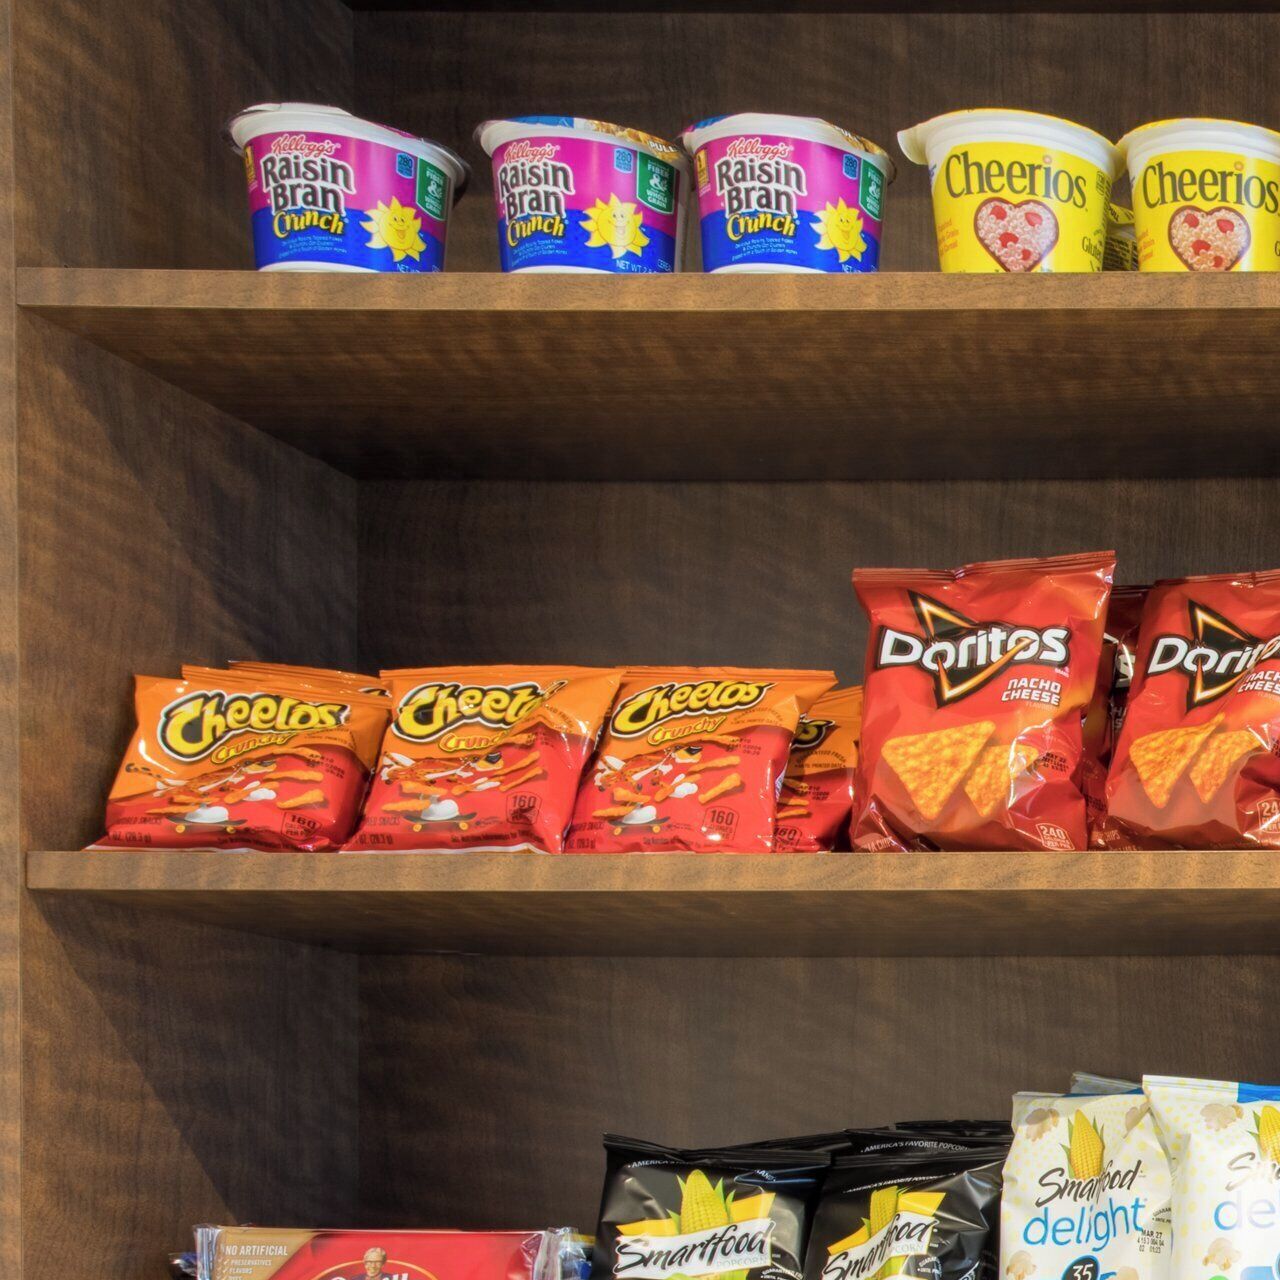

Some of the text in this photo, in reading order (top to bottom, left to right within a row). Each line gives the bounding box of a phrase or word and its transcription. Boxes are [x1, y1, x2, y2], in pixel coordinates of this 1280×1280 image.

[262, 155, 354, 193] Raisin
[499, 162, 574, 197] Raisin
[717, 158, 807, 195] Raisin
[945, 151, 1088, 209] Cheerios
[1143, 161, 1280, 213] Cheerios
[272, 182, 344, 216] Bran
[506, 189, 565, 222] Bran
[727, 185, 797, 218] Bran
[273, 210, 344, 238] Crunch
[507, 216, 565, 247] Crunch
[727, 212, 796, 241] Crunch
[880, 627, 1069, 670] Doritos
[1001, 689, 1061, 706] CHEESE
[1008, 677, 1061, 694] NACHO
[163, 690, 350, 759] Cheetos
[611, 680, 775, 736] Cheetos
[648, 715, 725, 746] Crunchy
[1023, 1196, 1146, 1252] delight
[225, 1245, 288, 1256] NO ARTIFICIAL
[613, 1217, 777, 1276] Smartfood
